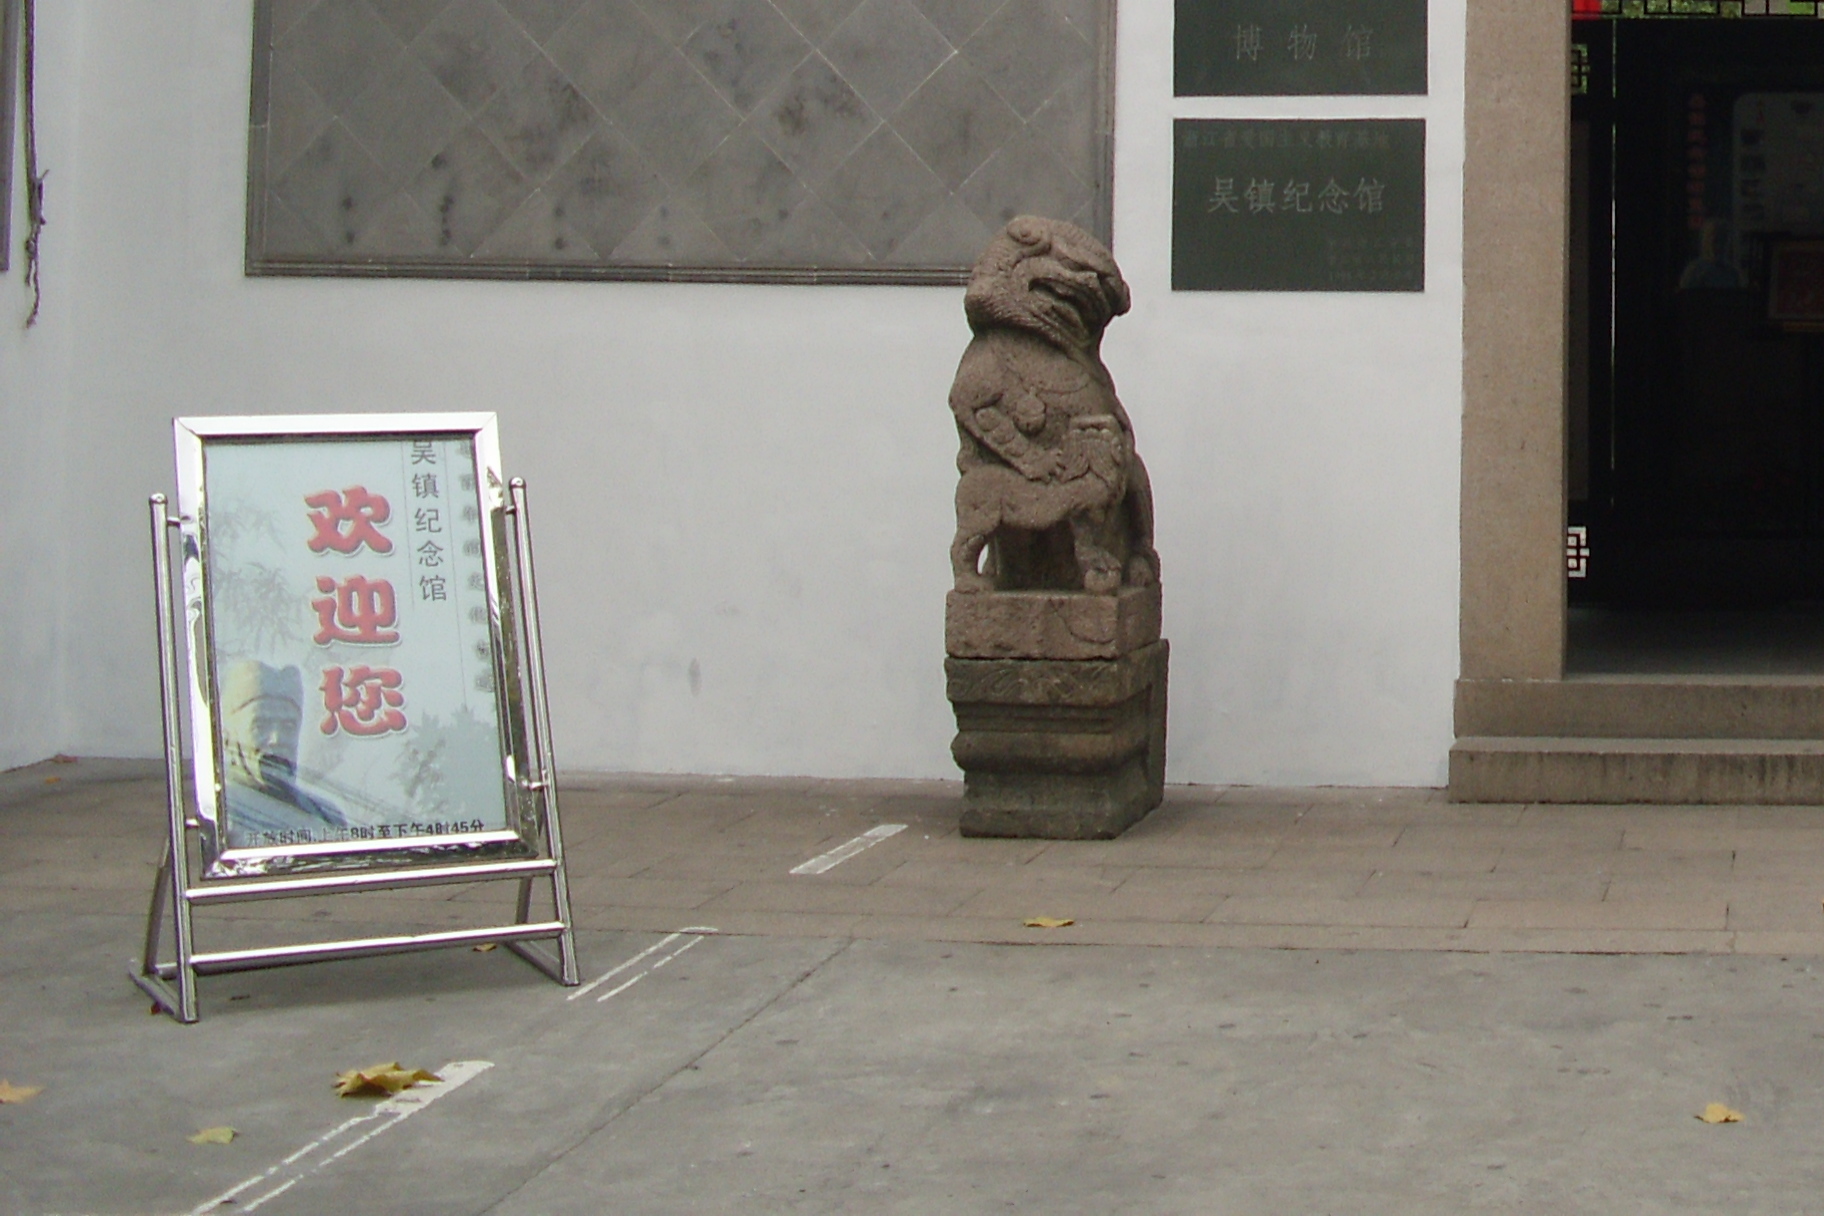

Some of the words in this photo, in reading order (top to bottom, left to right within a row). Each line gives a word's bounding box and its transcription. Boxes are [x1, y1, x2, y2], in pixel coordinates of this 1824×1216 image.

[1234, 23, 1374, 61] 博物馆
[1207, 177, 1386, 215] 吴镇纪念馆
[410, 441, 448, 603] 吴镇纪念馆
[304, 485, 408, 737] 欢迎您
